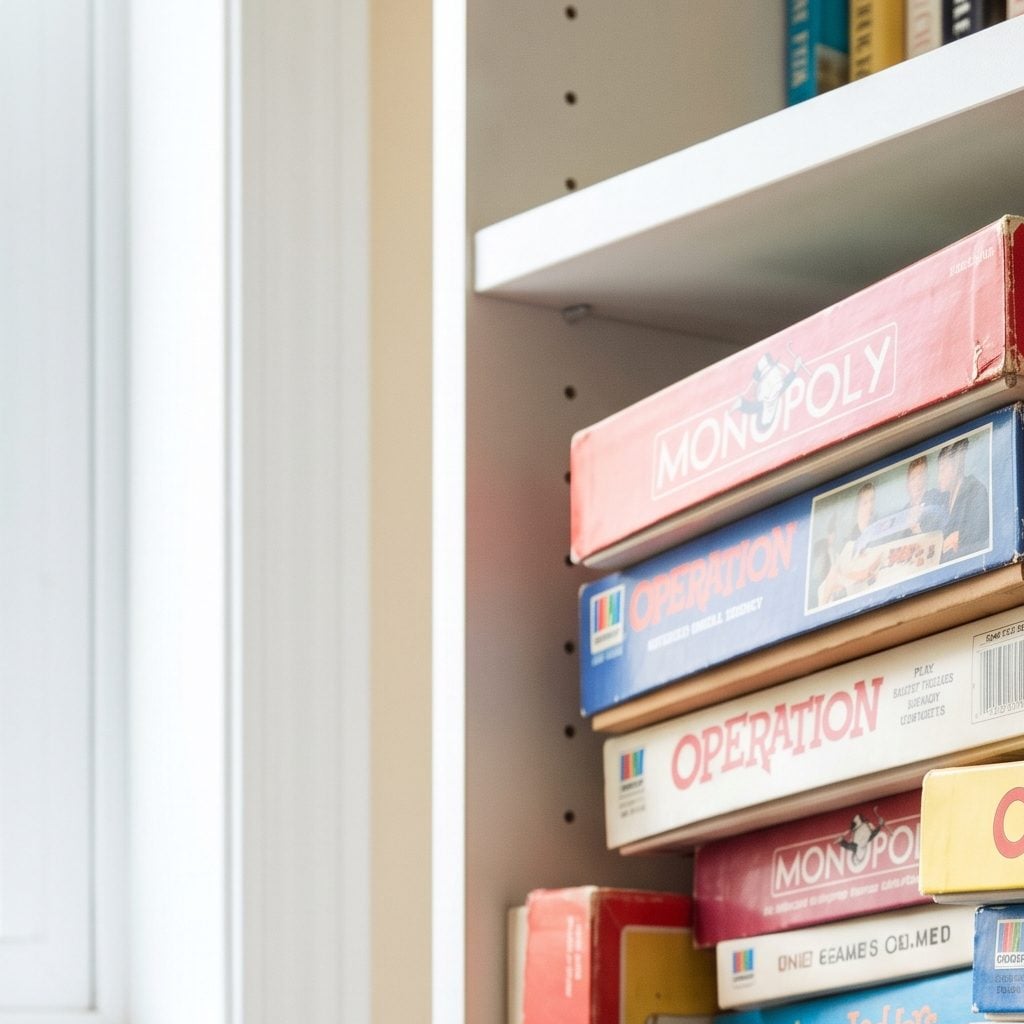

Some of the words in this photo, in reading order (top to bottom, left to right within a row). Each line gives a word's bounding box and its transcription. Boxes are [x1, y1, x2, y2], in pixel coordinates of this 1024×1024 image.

[629, 521, 798, 633] OPERATION
[671, 677, 884, 790] OPERATION
[775, 823, 921, 890] MONOPO
